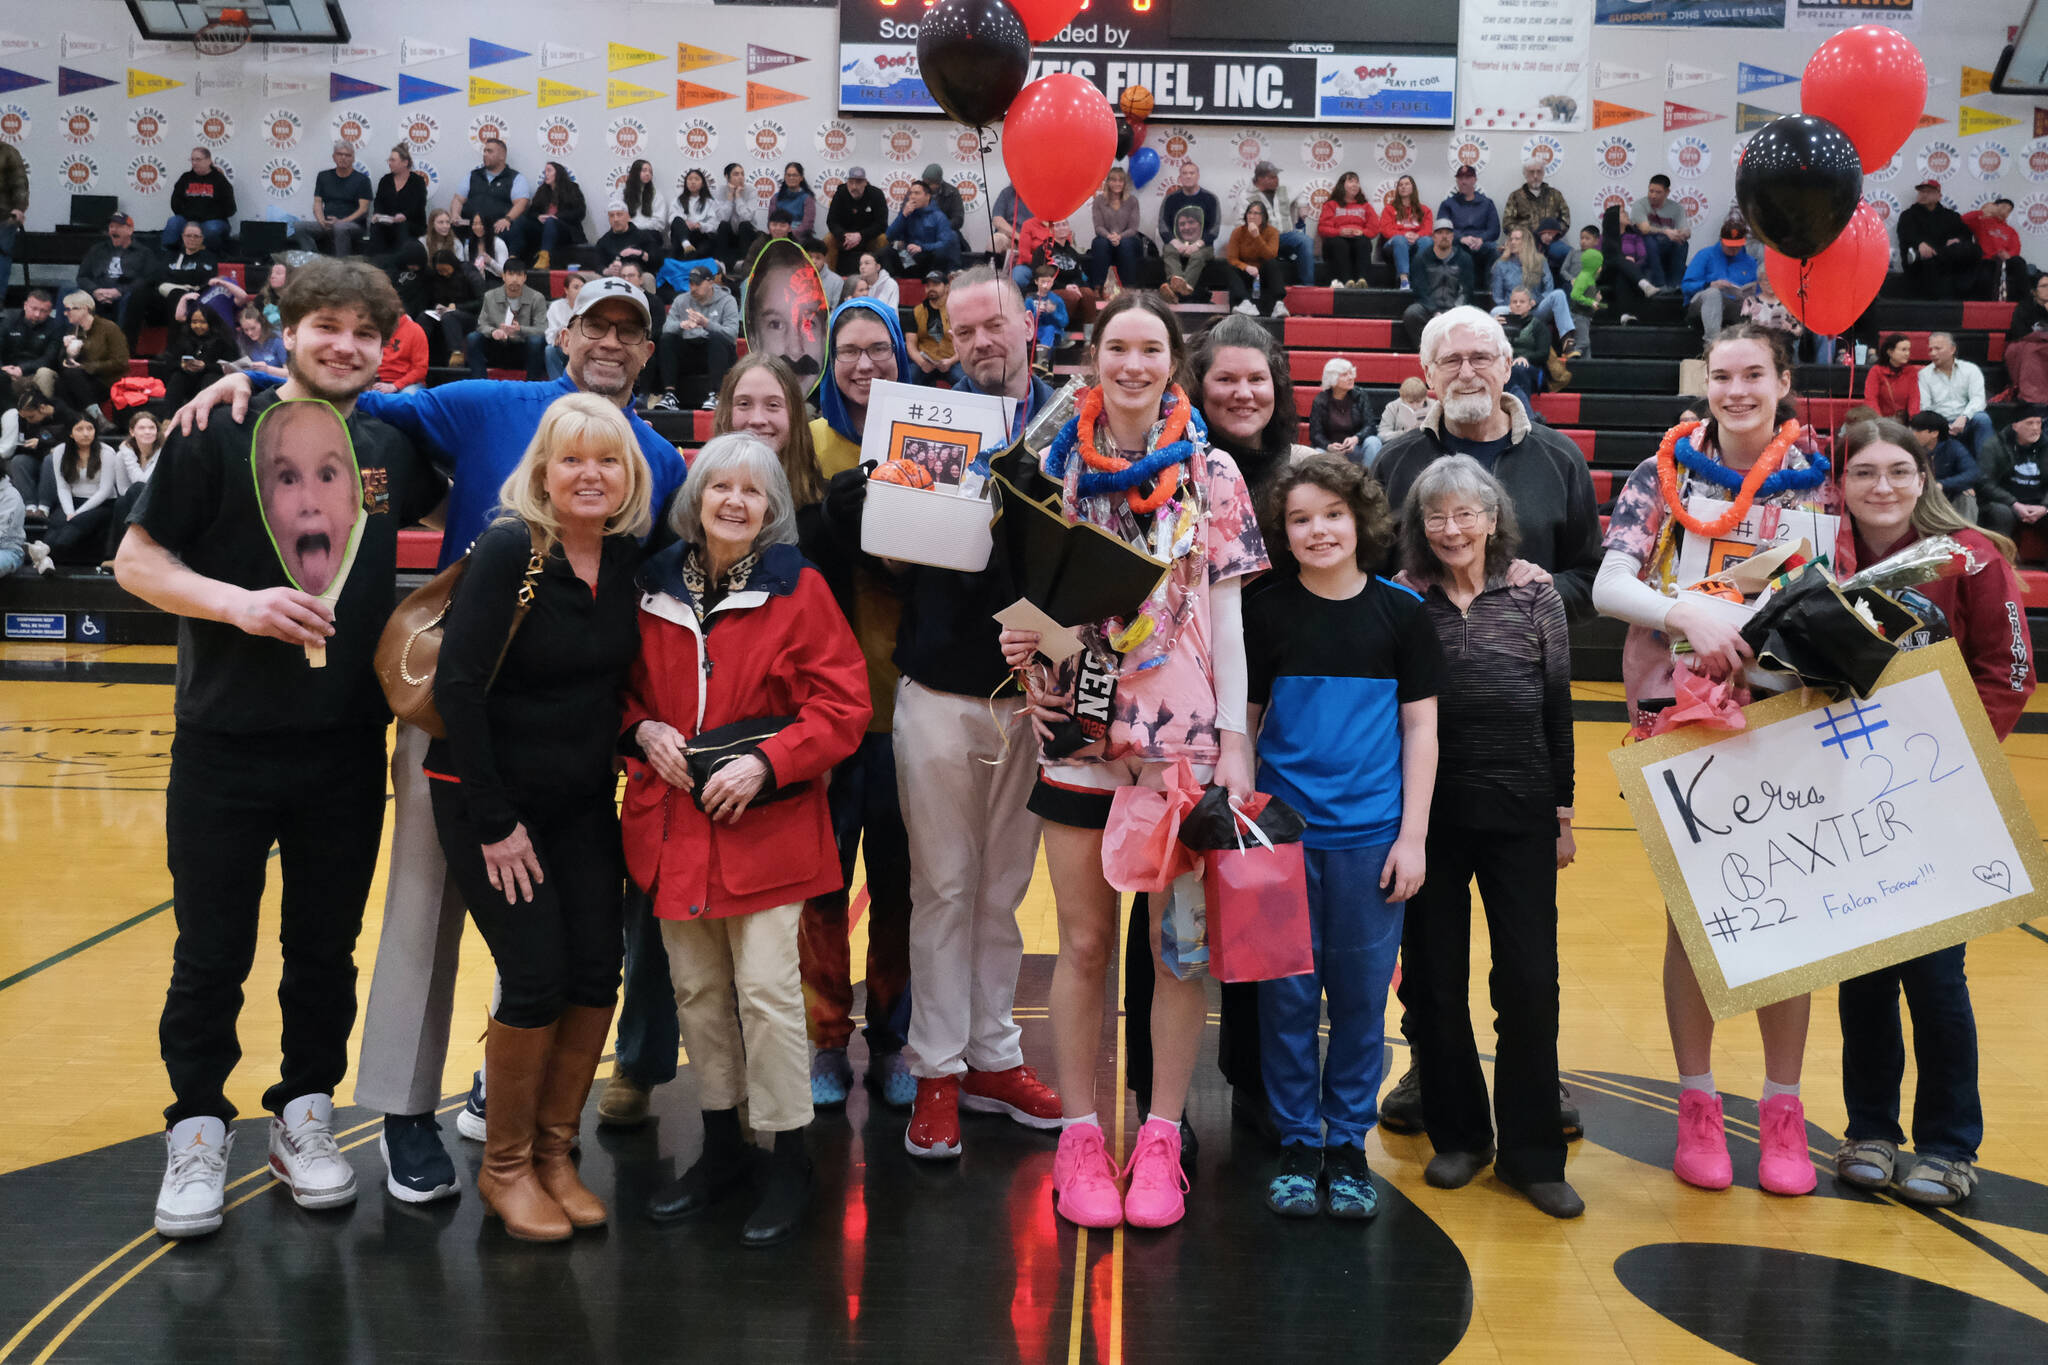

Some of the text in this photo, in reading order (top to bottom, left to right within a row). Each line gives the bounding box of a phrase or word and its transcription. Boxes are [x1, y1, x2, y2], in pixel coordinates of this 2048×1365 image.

[1609, 7, 1775, 23] SUPPORTS JDHS VOLLEYBALL
[1797, 11, 1913, 20] PRINT MEDIA
[1105, 24, 1130, 48] by
[1213, 64, 1293, 110] INC.
[1419, 76, 1440, 86] COOL
[75, 105, 98, 122] CHAMP
[144, 107, 167, 124] CHAMP
[210, 108, 234, 126] CHAMP
[278, 110, 302, 127] CHAMP
[347, 111, 370, 128] CHAMP
[415, 112, 438, 130] CHAMP
[1674, 112, 1708, 120] STATE CHAMPS
[484, 114, 508, 132] CHAMP
[554, 116, 578, 133] CHAMP
[623, 117, 646, 134] CHAMP
[693, 118, 716, 136] CHAMP
[762, 120, 786, 137] CHAMP
[832, 120, 855, 138] CHAMP
[64, 133, 95, 145] JUNEAU
[132, 135, 164, 147] JUNEAU
[196, 134, 231, 148] KETCHIKAN
[266, 138, 298, 150] JUNEAU
[1173, 127, 1196, 144] CHAMP
[1318, 131, 1342, 148] CHAMP
[1392, 132, 1416, 150] CHAMP
[1464, 134, 1488, 151] CHAMP
[542, 144, 574, 156] JUNEAU
[612, 145, 643, 157] JUNEAU
[682, 146, 713, 158] JUNEAU
[1539, 136, 1562, 153] CHAMP
[1612, 136, 1635, 153] CHAMP
[1935, 141, 1958, 158] CHAMP
[750, 148, 782, 160] JUNEAU
[820, 148, 852, 160] JUNEAU
[886, 150, 917, 162] JUNEAU
[59, 154, 99, 177] STATE CHAMP
[127, 156, 167, 178] STATE CHAMP
[261, 159, 301, 182] STATE CHAMP
[1307, 159, 1338, 171] JUNEAU
[1598, 161, 1632, 176] KETCHIKAN
[814, 168, 831, 189] STATE
[64, 182, 91, 193] COLONY
[132, 182, 163, 194] JUNEAU
[266, 186, 294, 198] COLONY
[1593, 185, 1612, 208] STATE
[908, 403, 953, 425] #23
[1732, 520, 1791, 541] #2
[1721, 800, 1913, 902] BAXTER
[1705, 863, 1937, 943] #22 Falcon Forever!!!
